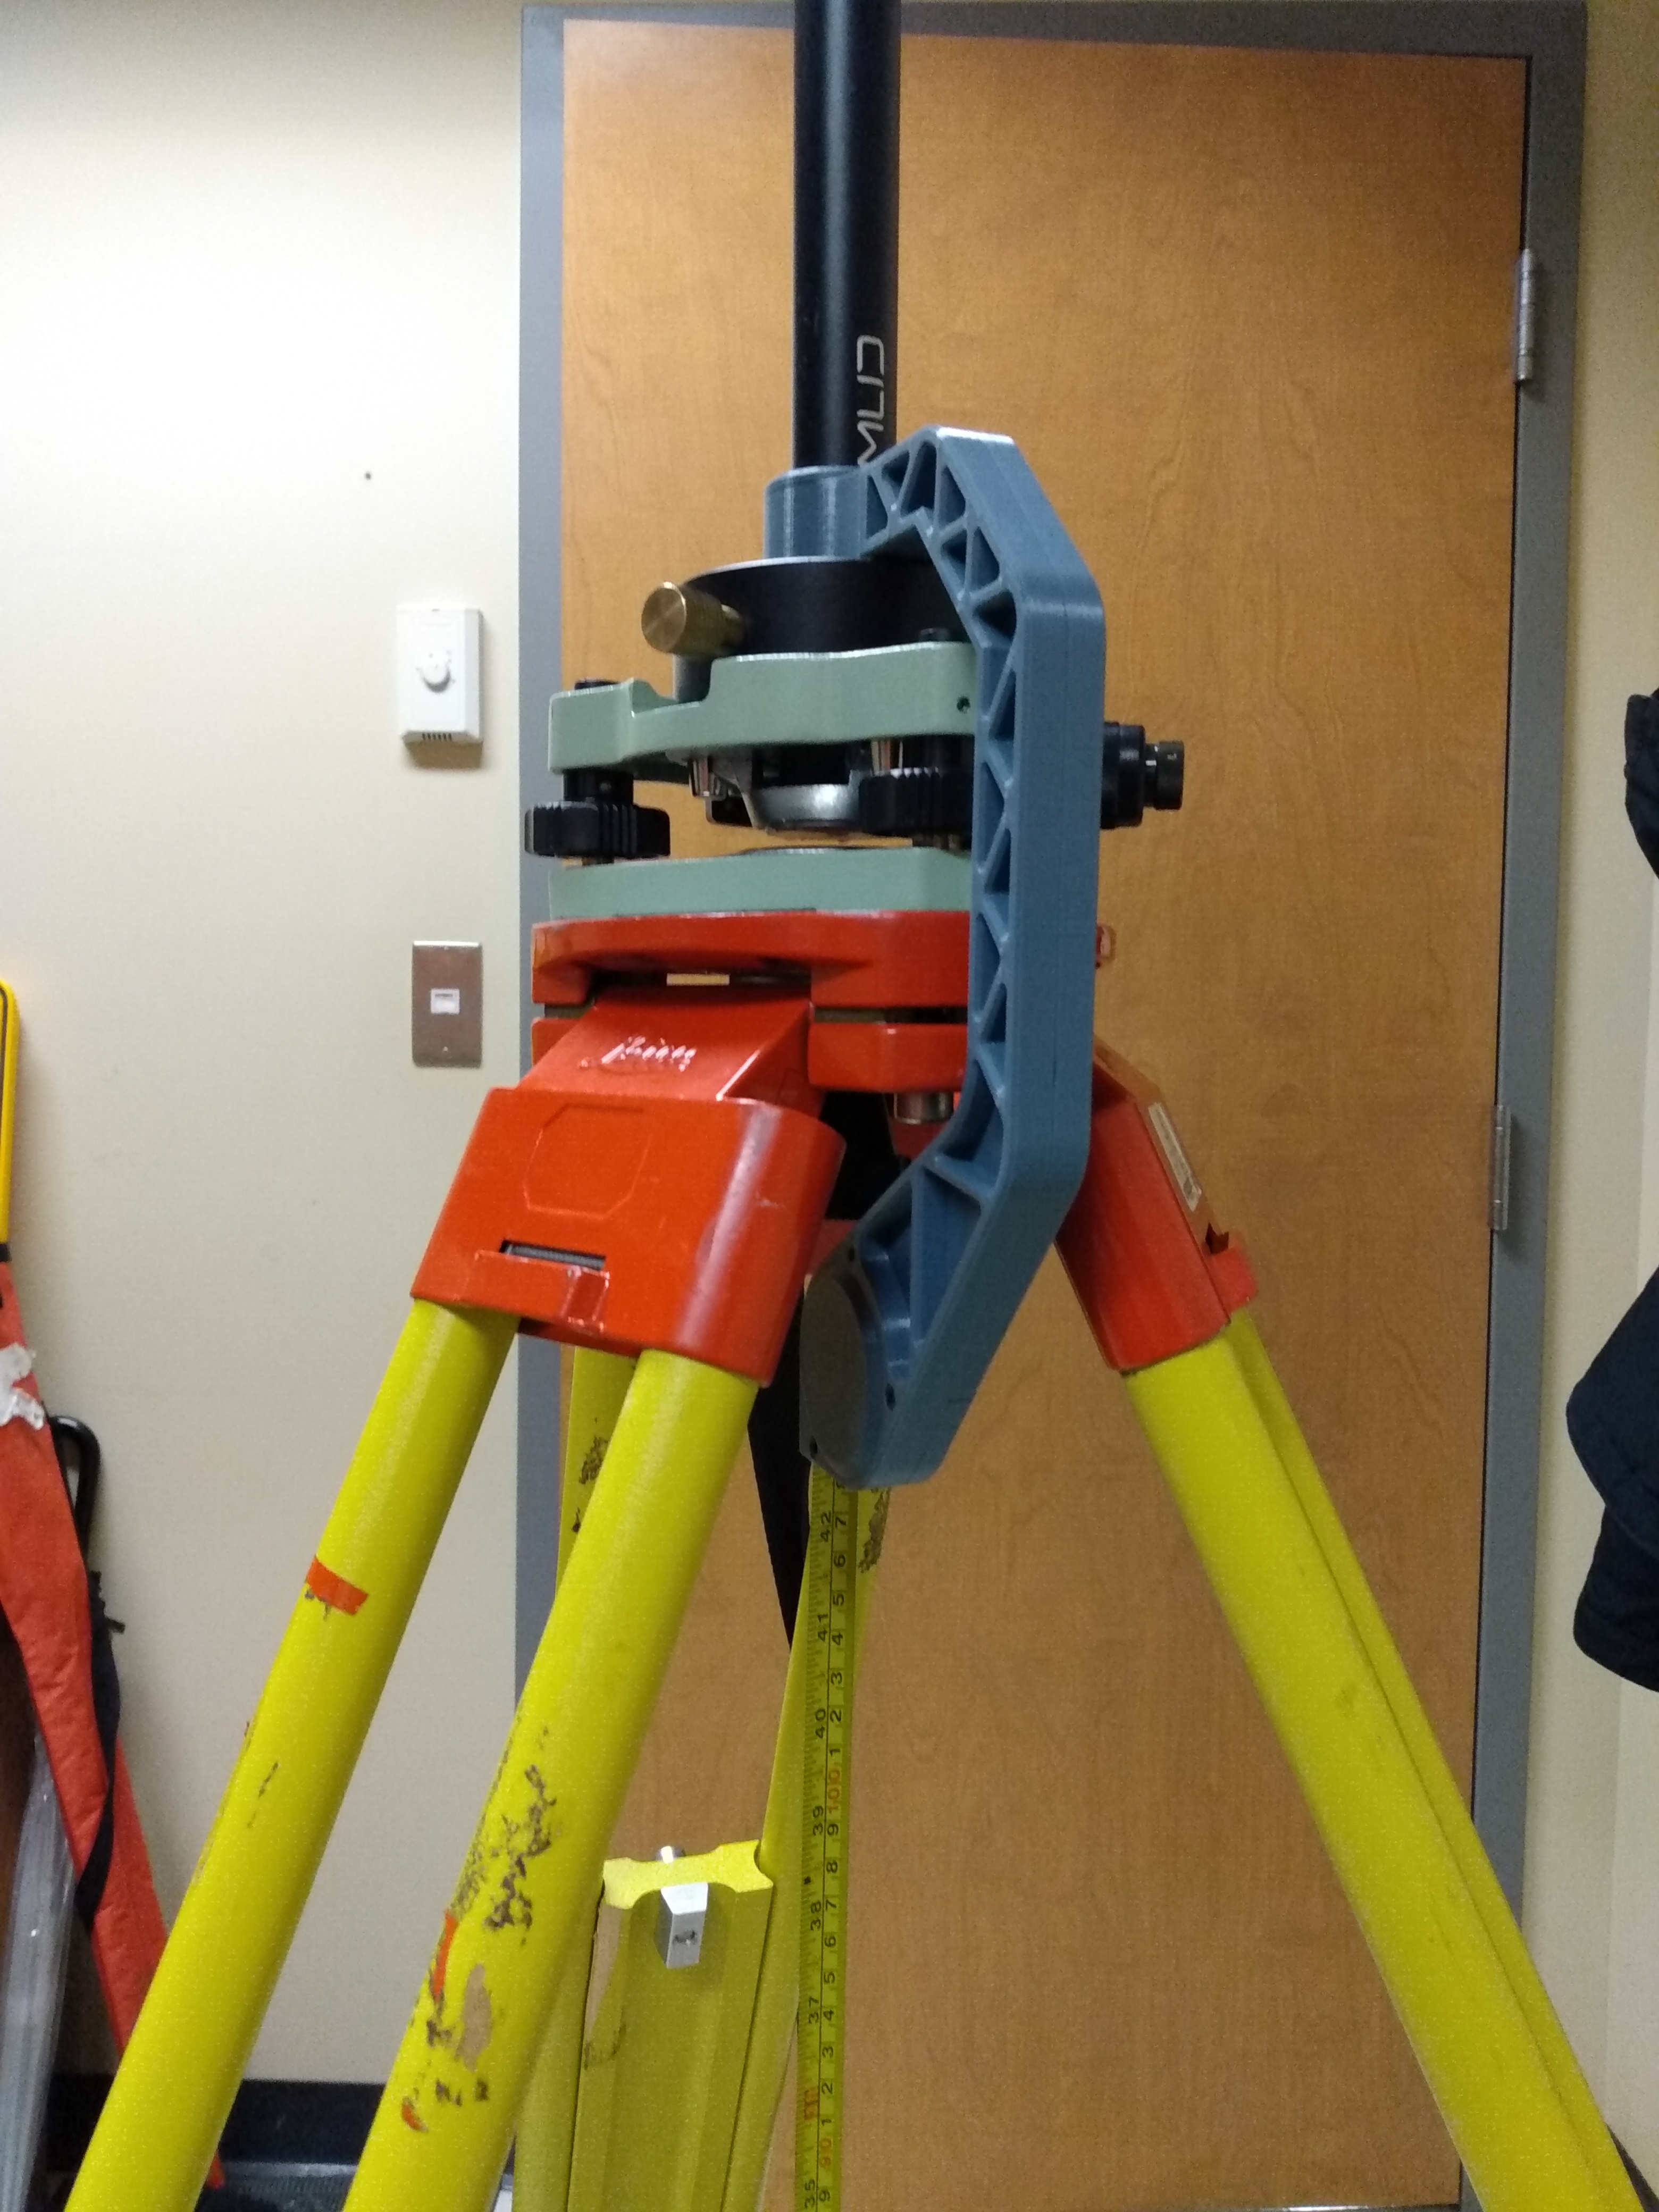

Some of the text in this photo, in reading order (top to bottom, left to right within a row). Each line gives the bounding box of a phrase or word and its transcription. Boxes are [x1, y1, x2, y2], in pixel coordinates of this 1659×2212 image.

[820, 1510, 831, 1543] 42
[835, 1516, 847, 1528] 7
[834, 1554, 846, 1568] 6
[833, 1594, 844, 1606] 5
[817, 1613, 828, 1642] 41
[832, 1632, 843, 1646] 4
[831, 1671, 843, 1685] 3
[830, 1709, 842, 1723] 2
[815, 1708, 826, 1739] 40
[830, 1747, 841, 1757] 1
[812, 1806, 824, 1836] 39
[827, 1823, 839, 1836] 9
[826, 1861, 837, 1873] 8
[826, 1899, 837, 1911] 7
[810, 1900, 821, 1931] 38
[824, 1936, 836, 1948] 6
[824, 1972, 835, 1984] 5
[808, 1996, 819, 2024] 37
[823, 2009, 834, 2021] 4
[822, 2046, 834, 2058] 3
[821, 2082, 833, 2094] 2
[821, 2118, 832, 2126] 1
[804, 2179, 816, 2209] 35
[819, 2188, 831, 2202] 9
